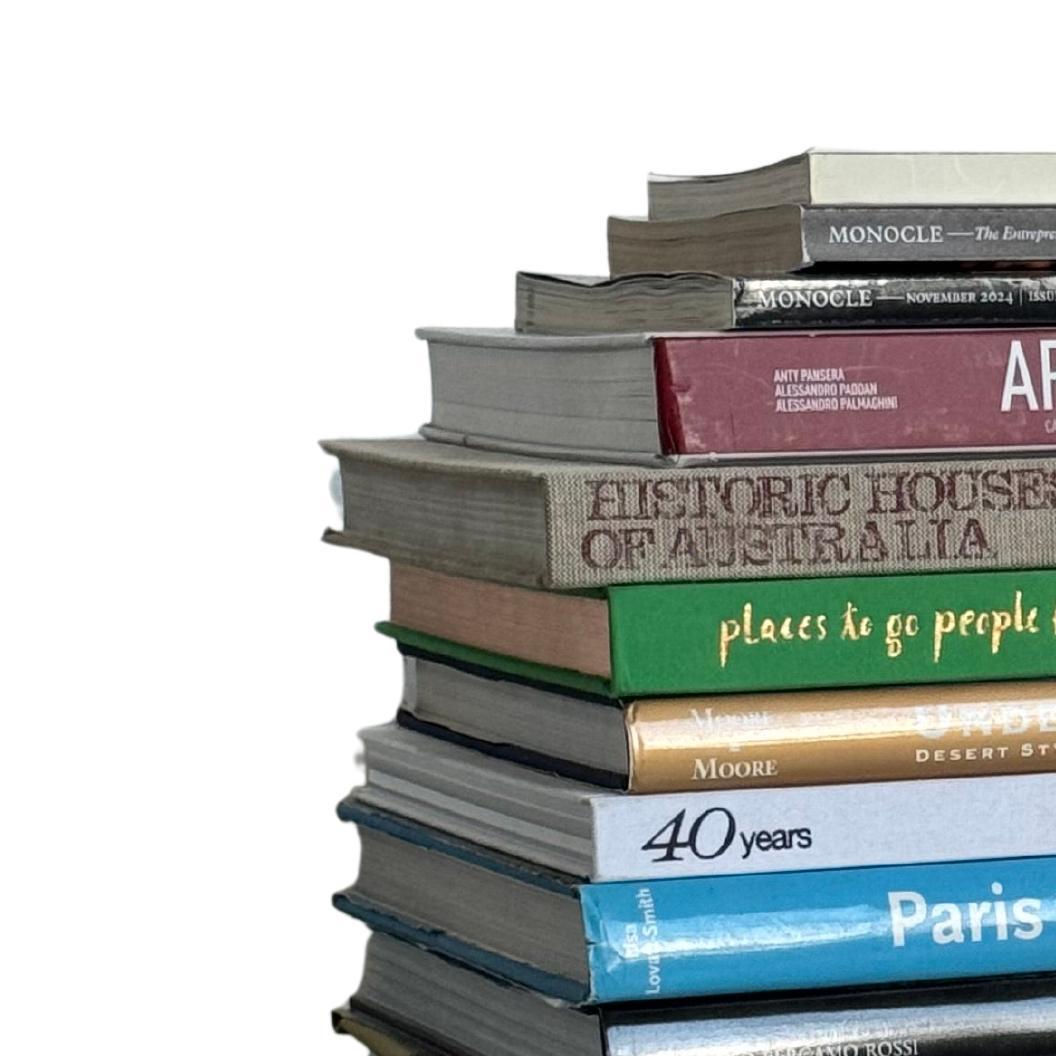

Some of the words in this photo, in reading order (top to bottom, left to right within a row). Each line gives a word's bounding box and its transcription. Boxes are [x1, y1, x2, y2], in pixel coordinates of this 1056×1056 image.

[829, 225, 944, 243] MONOCLE
[974, 226, 999, 241] The
[757, 289, 874, 308] MONOCLE
[906, 291, 976, 304] NOVEMBER
[980, 291, 1013, 305] 2024
[773, 369, 800, 382] ANTY
[800, 367, 846, 382] PANSERA
[774, 383, 838, 397] ALESSANDRO
[775, 397, 839, 412] ALESSANDRO
[584, 471, 851, 521] HISTORIC
[580, 527, 655, 570] OF
[662, 517, 997, 568] AUSTRALIA
[719, 601, 828, 668] places
[841, 600, 874, 641] to
[886, 611, 919, 658] go
[933, 589, 1041, 664] people
[914, 746, 1010, 763] DESERT
[690, 757, 779, 781] MOORE
[640, 806, 737, 864] 40
[738, 825, 814, 861] years
[886, 880, 1044, 949] Paris
